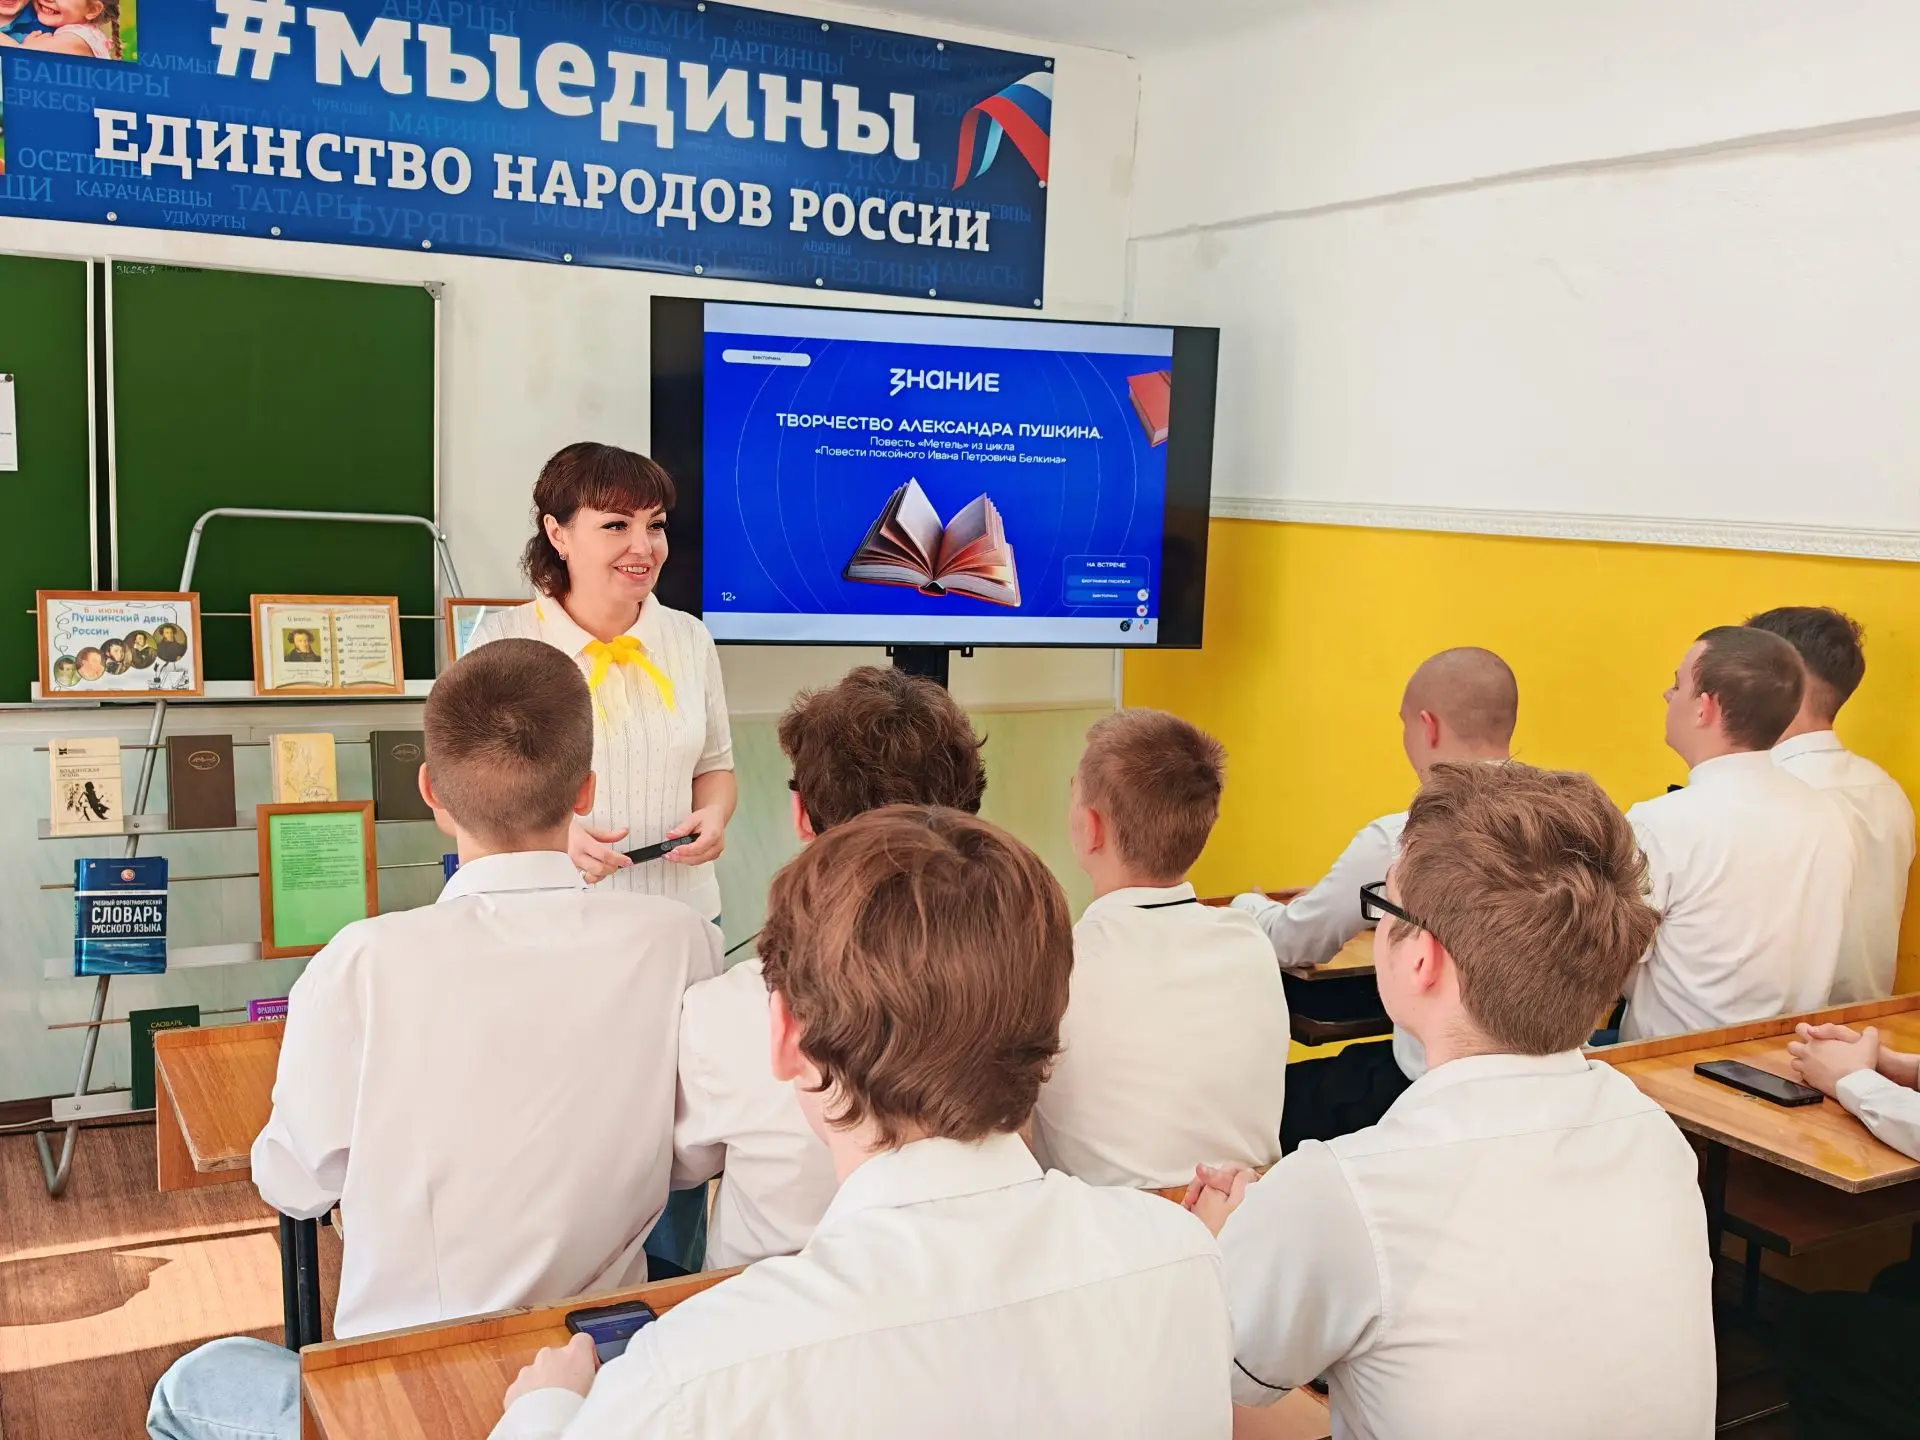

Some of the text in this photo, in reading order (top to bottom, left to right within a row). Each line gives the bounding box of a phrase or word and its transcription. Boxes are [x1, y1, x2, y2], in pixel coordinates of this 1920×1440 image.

[601, 1, 706, 43] КОМИ
[138, 53, 216, 76] КАЛМЫ
[710, 36, 844, 76] ДАРГИНЦЫ
[849, 35, 950, 71] РУССКИЕ
[13, 57, 170, 98] БАШКИРЫ
[4, 86, 96, 114] ЕРКЕСЫ
[93, 107, 990, 252] ЕДИНСТВО НАРОДОВ РОССИИ
[76, 180, 213, 208] КАРАЧАЕВЦЫ
[231, 184, 364, 220] ТАТАРЫ
[163, 209, 246, 230] УДМУРТЫ
[352, 203, 508, 247] БУРЯТЫ
[776, 413, 1104, 439] ТВОРЧЕСТВО АЛЕКСАНДРА ПУШКИНА.
[815, 446, 1067, 464] «Повести покойного Ивана Петровича Белкина»
[870, 436, 1015, 452] Повесть «Метель» из цикла
[721, 591, 736, 602] 12+
[71, 613, 169, 625] Пушкинский день
[72, 627, 110, 636] России
[91, 906, 163, 924] СЛОВАРЬ
[91, 923, 162, 934] РУССКОГО ЯЗЫКА
[150, 1020, 183, 1028] СЛОВАРЬ
